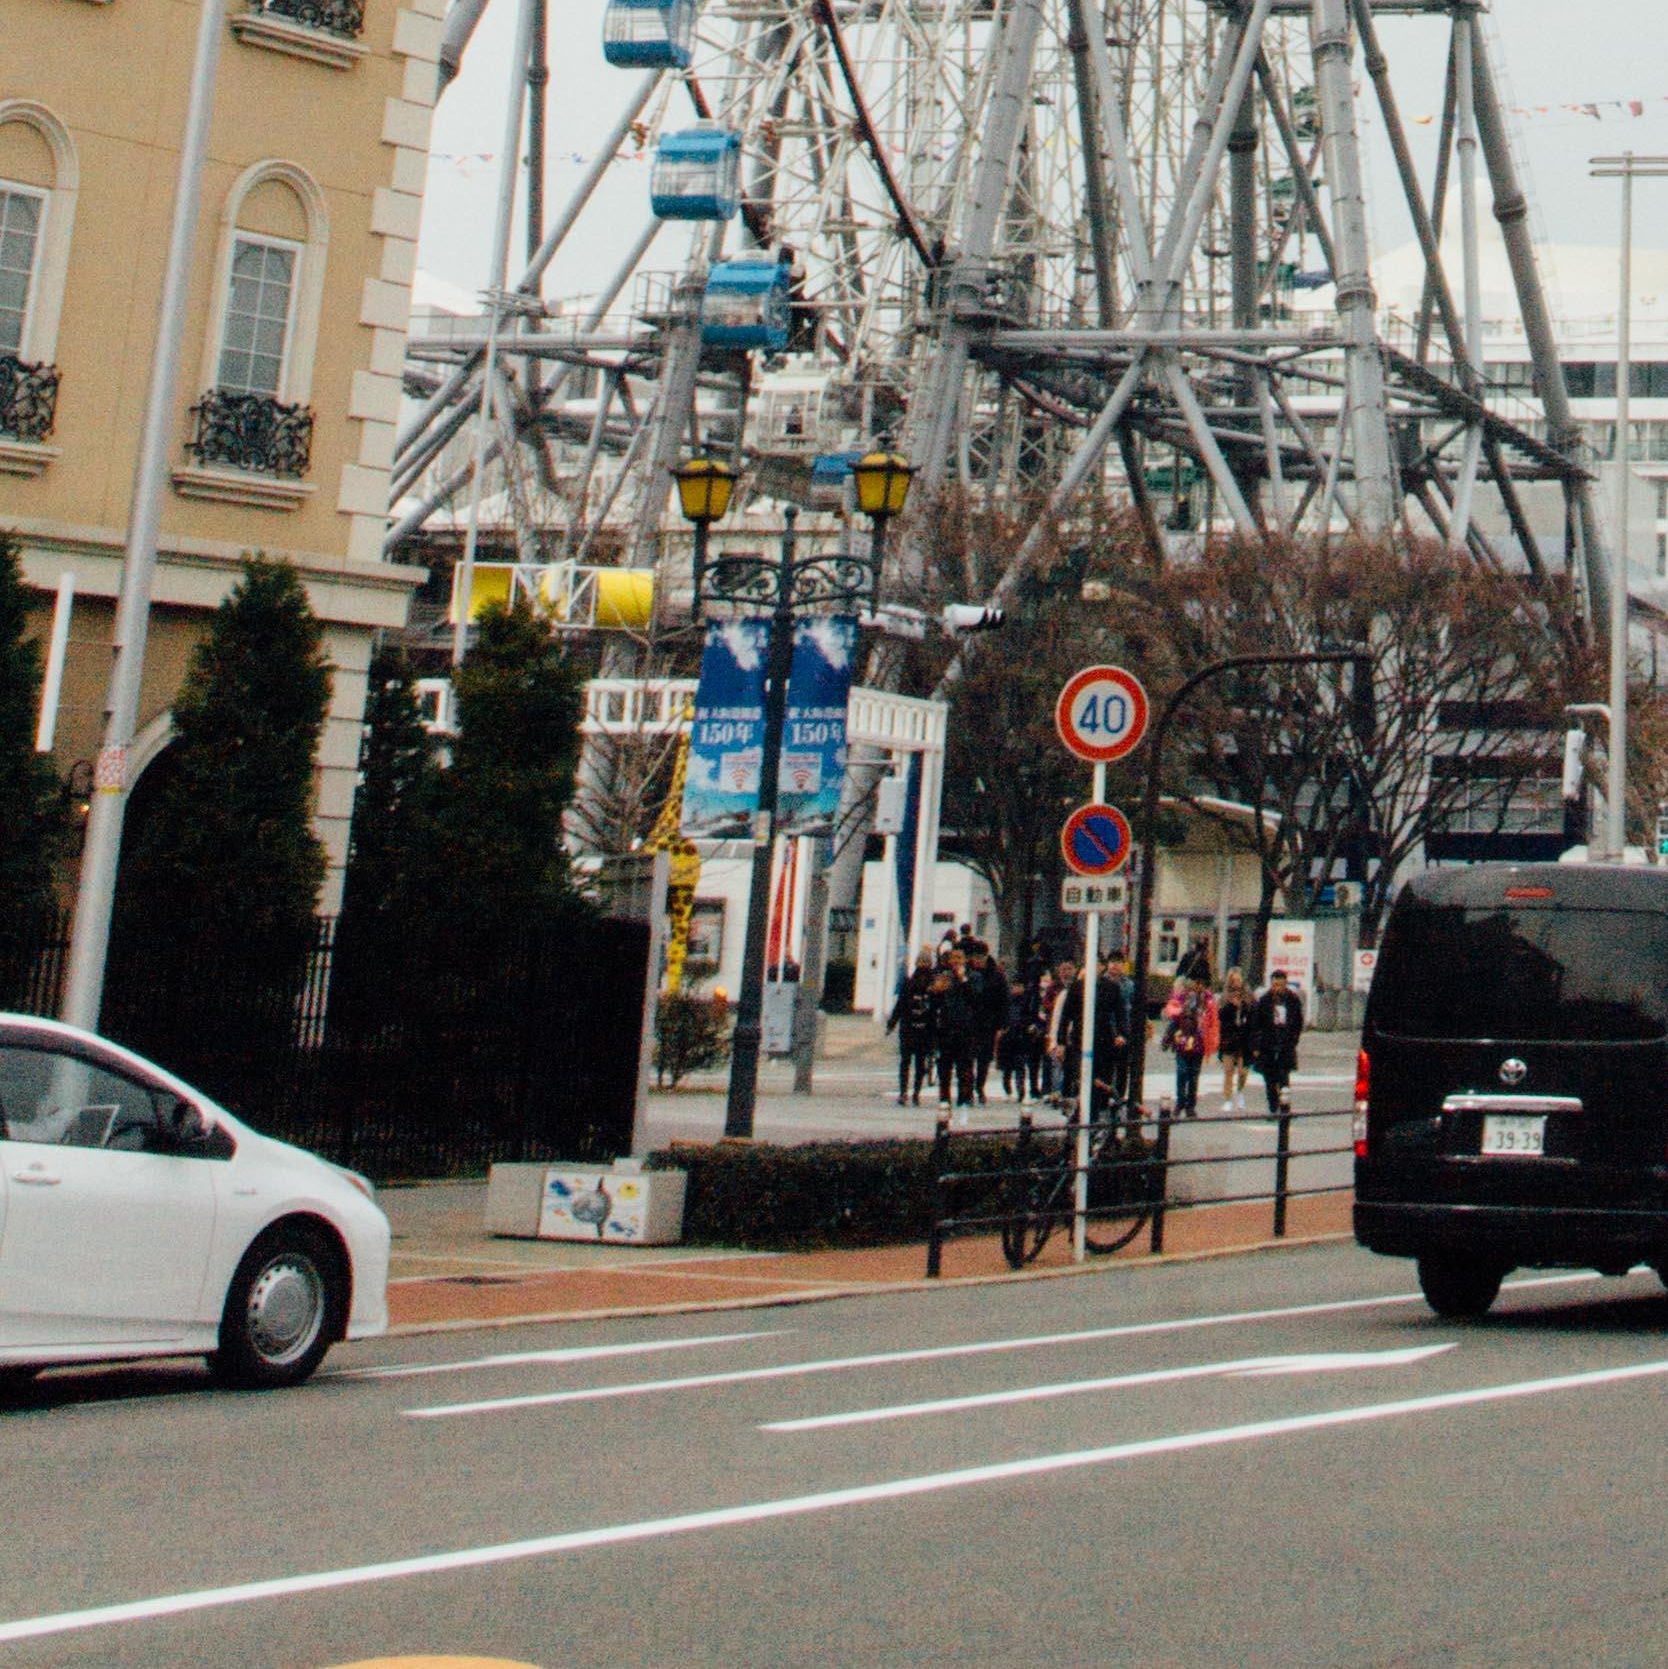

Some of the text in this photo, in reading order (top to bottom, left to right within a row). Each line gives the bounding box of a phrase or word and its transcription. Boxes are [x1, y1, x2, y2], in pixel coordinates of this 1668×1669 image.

[1079, 694, 1126, 734] 40
[1065, 886, 1122, 904] 自動車
[1495, 1131, 1541, 1150] 39-39
